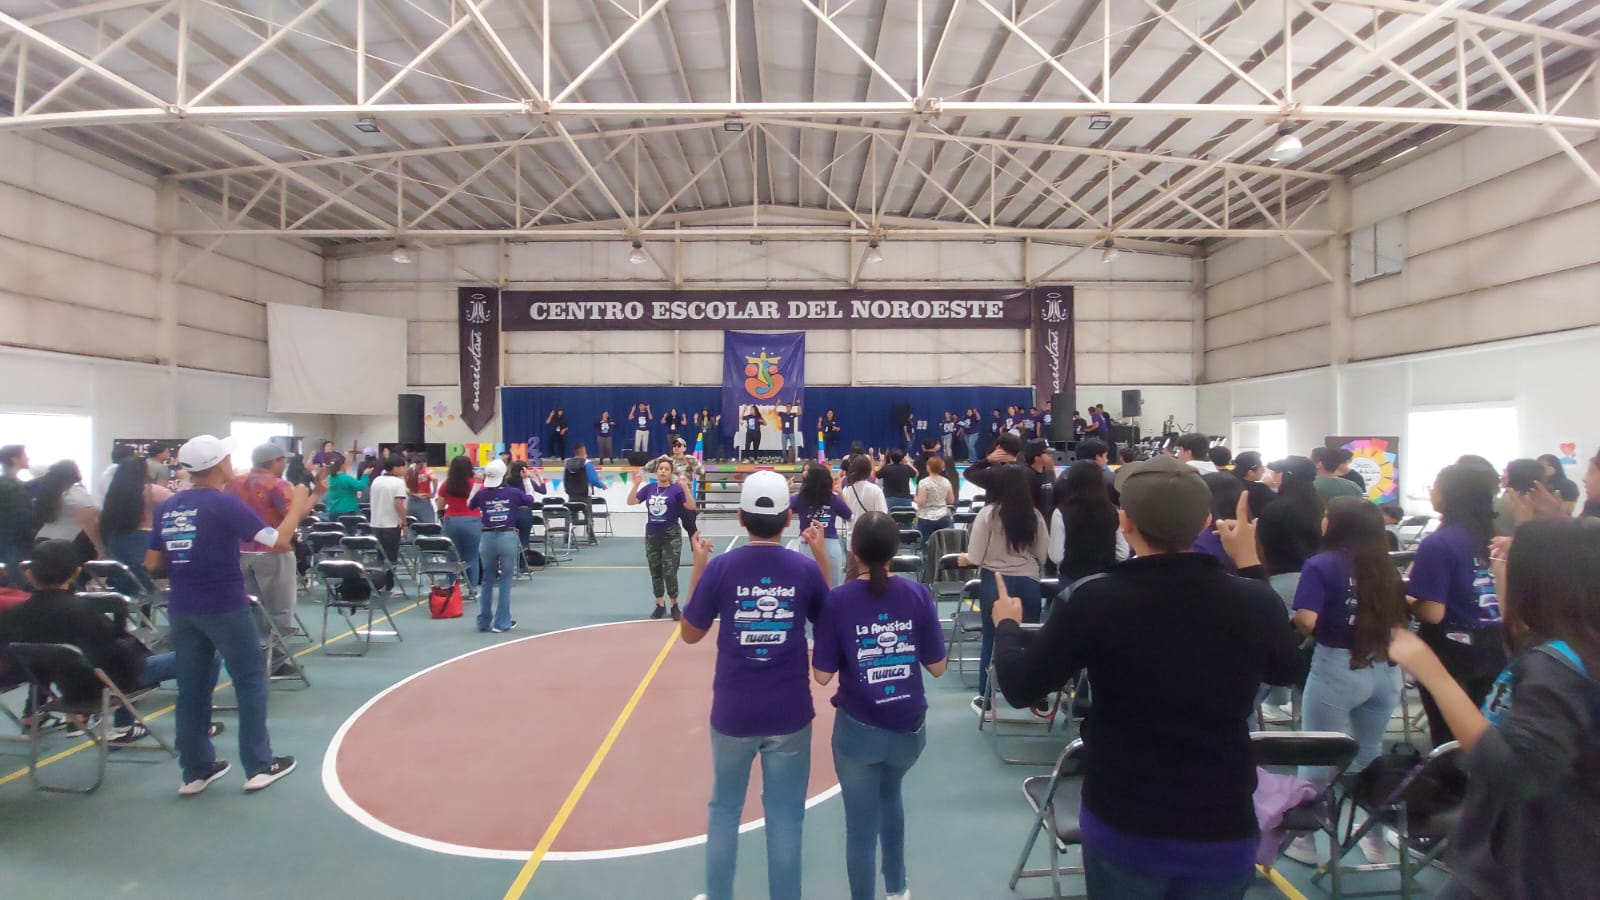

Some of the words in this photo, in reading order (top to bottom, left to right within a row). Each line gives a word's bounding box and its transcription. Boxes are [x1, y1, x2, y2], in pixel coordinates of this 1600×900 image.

[530, 301, 644, 320] CENTRO
[651, 301, 781, 320] ESCOLAR
[787, 300, 843, 319] DEL
[850, 300, 1004, 319] NOROESTE
[736, 585, 750, 596] La
[751, 585, 795, 597] Amistad
[856, 624, 869, 636] La
[871, 619, 912, 635] Amistad
[745, 633, 781, 643] nunca
[872, 667, 905, 681] nunca
